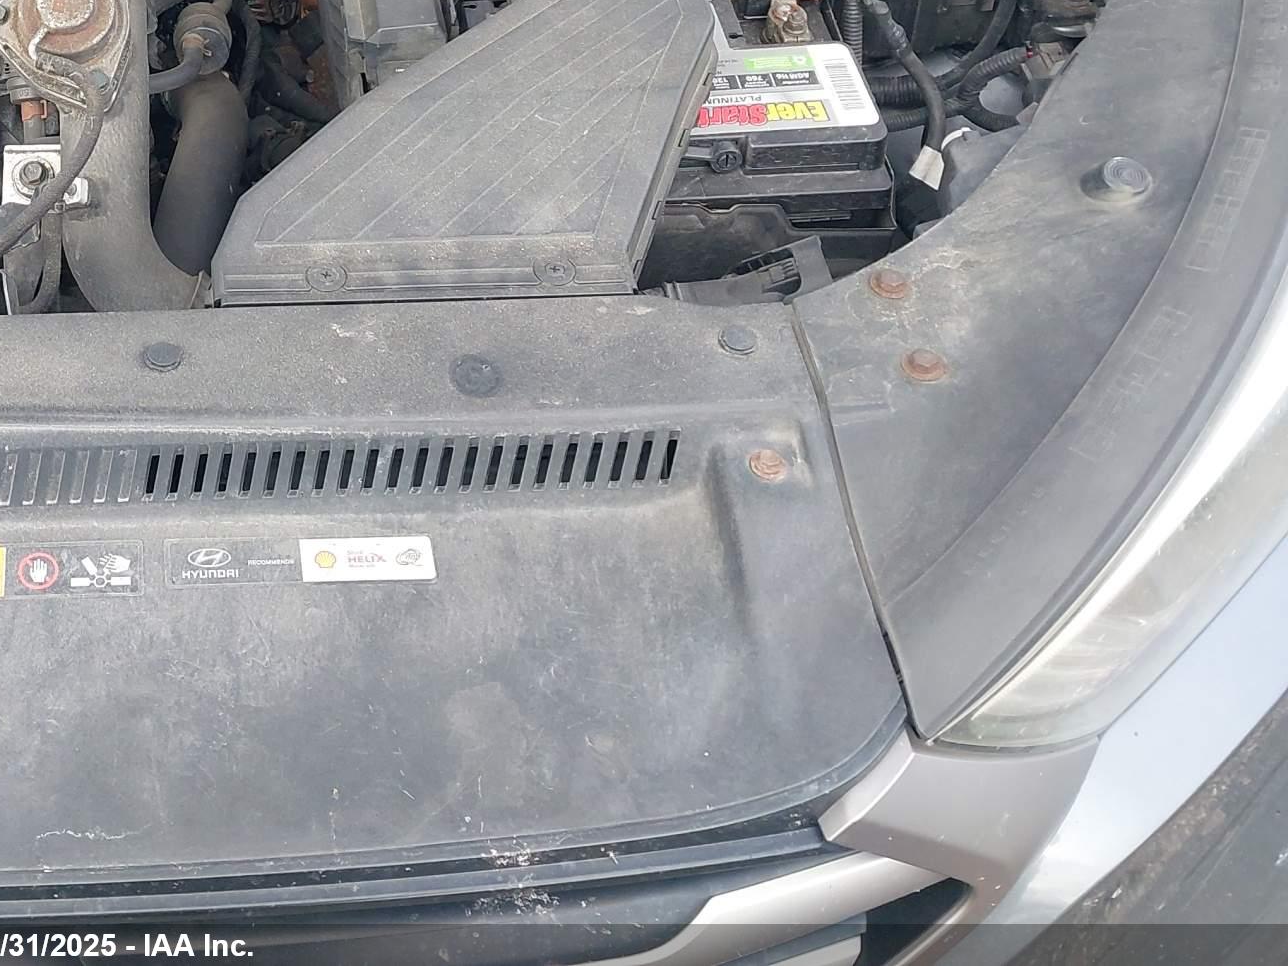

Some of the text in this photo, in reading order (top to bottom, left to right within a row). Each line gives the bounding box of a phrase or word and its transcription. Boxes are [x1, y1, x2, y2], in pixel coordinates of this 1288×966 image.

[698, 101, 830, 129] EverStart
[347, 553, 387, 563] HELIX
[181, 568, 240, 579] HYUNDAI
